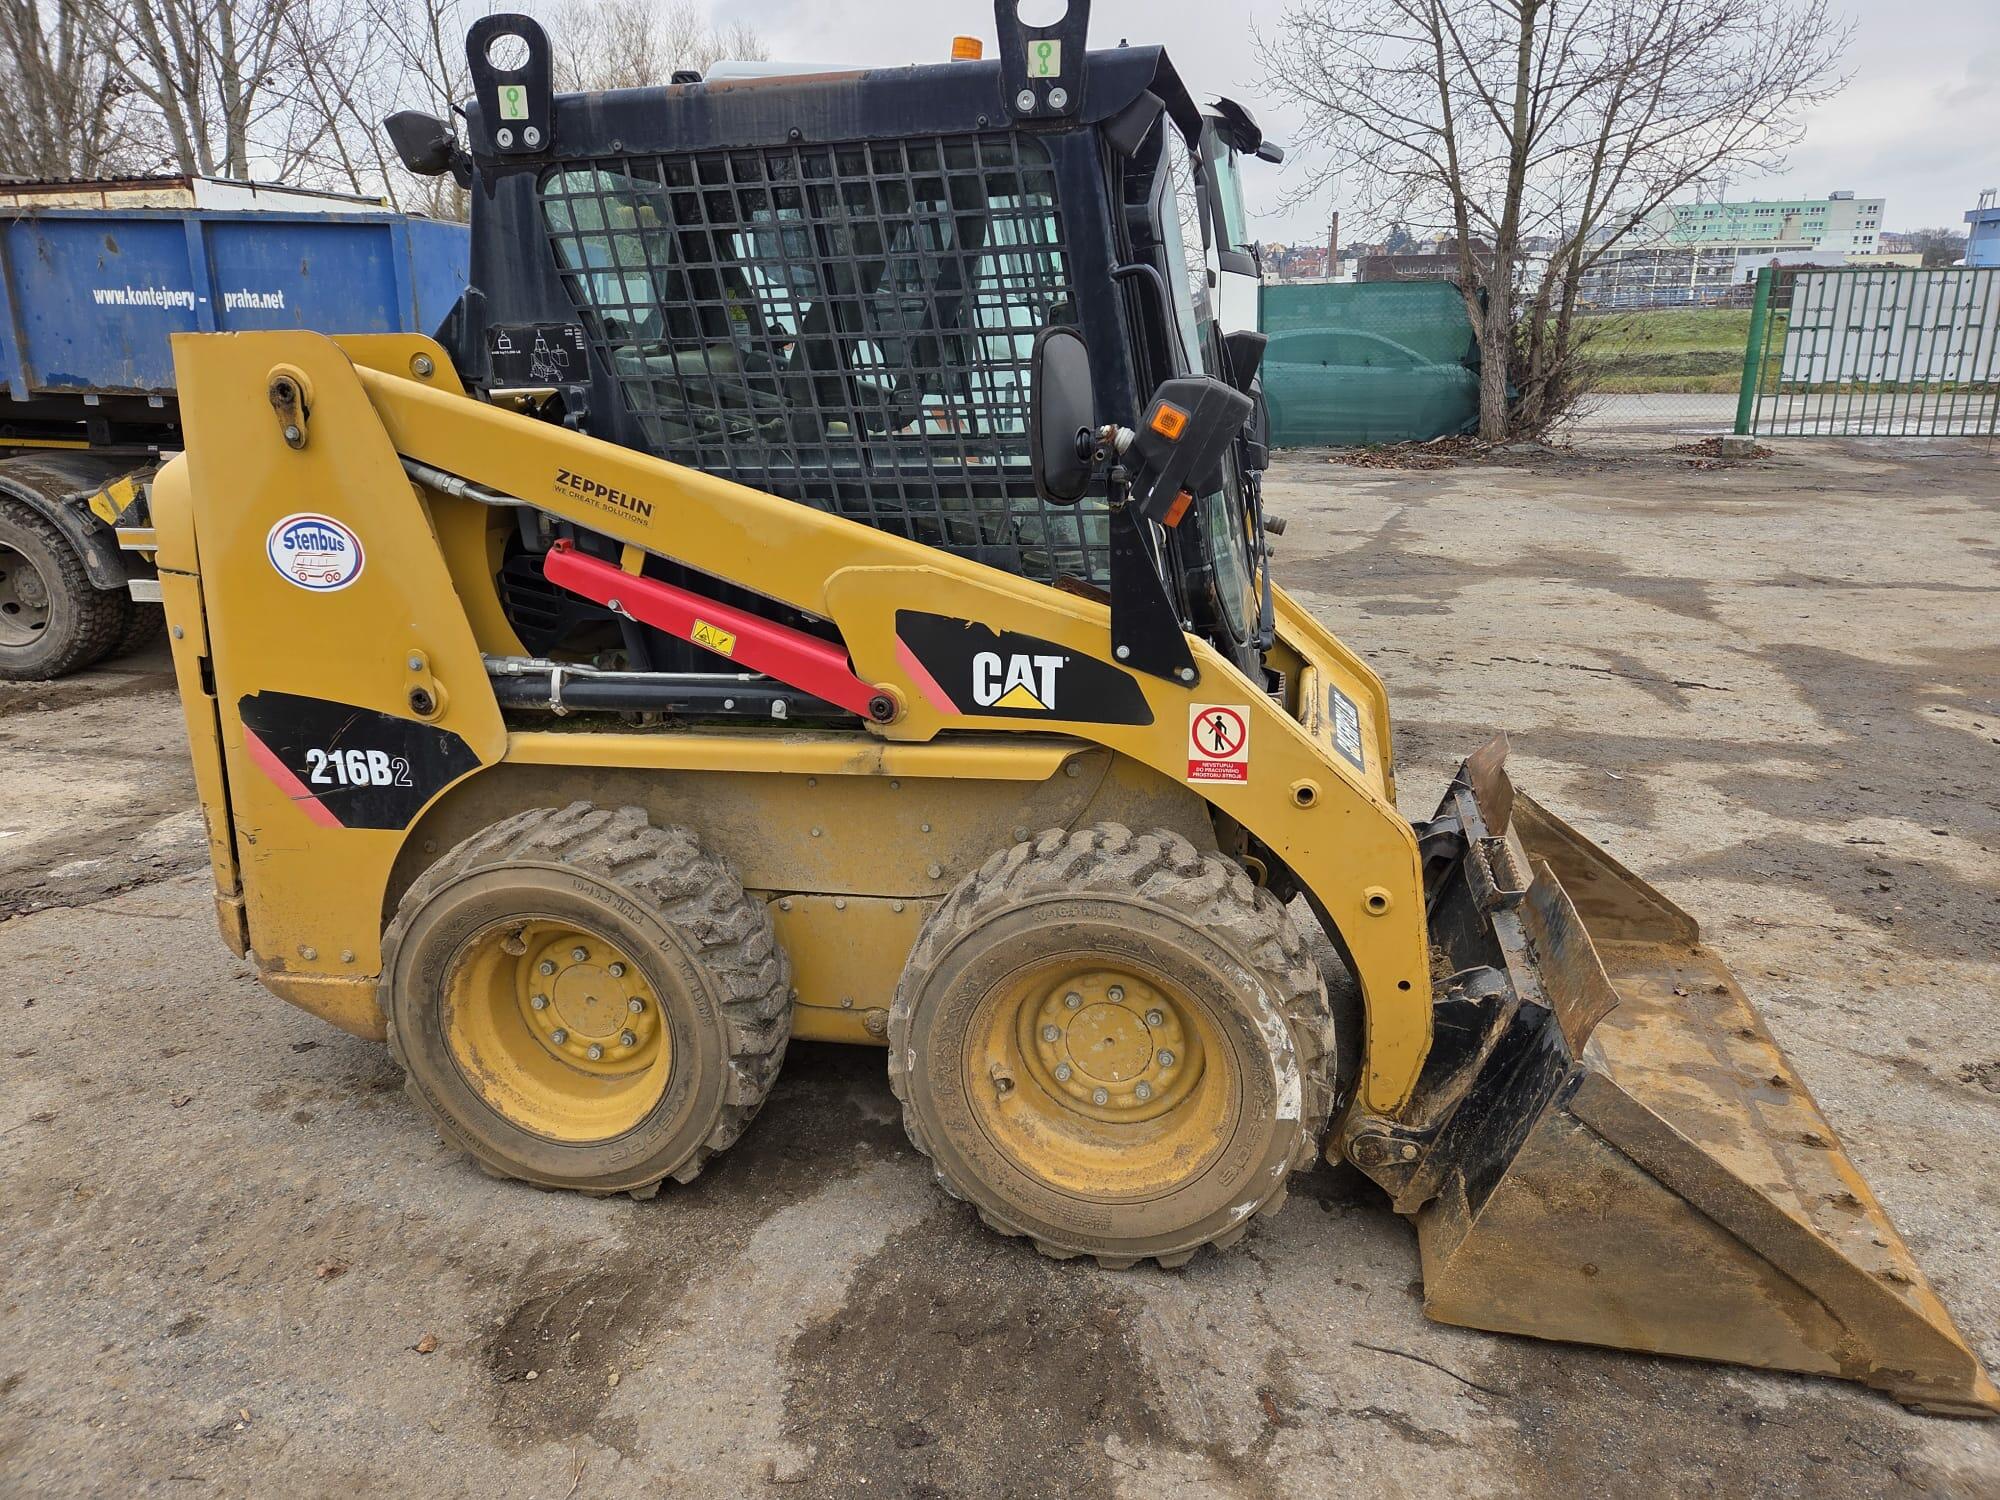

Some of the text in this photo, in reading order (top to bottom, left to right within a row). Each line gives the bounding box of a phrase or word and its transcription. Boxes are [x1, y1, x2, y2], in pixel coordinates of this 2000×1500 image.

[93, 285, 195, 311] www.kontejnery
[223, 288, 285, 312] praha.net
[554, 484, 648, 526] WE CREATE SOLUTIONS
[556, 468, 652, 518] ZEPPELIN
[283, 528, 345, 552] Stenbus
[972, 651, 1064, 711] CAT
